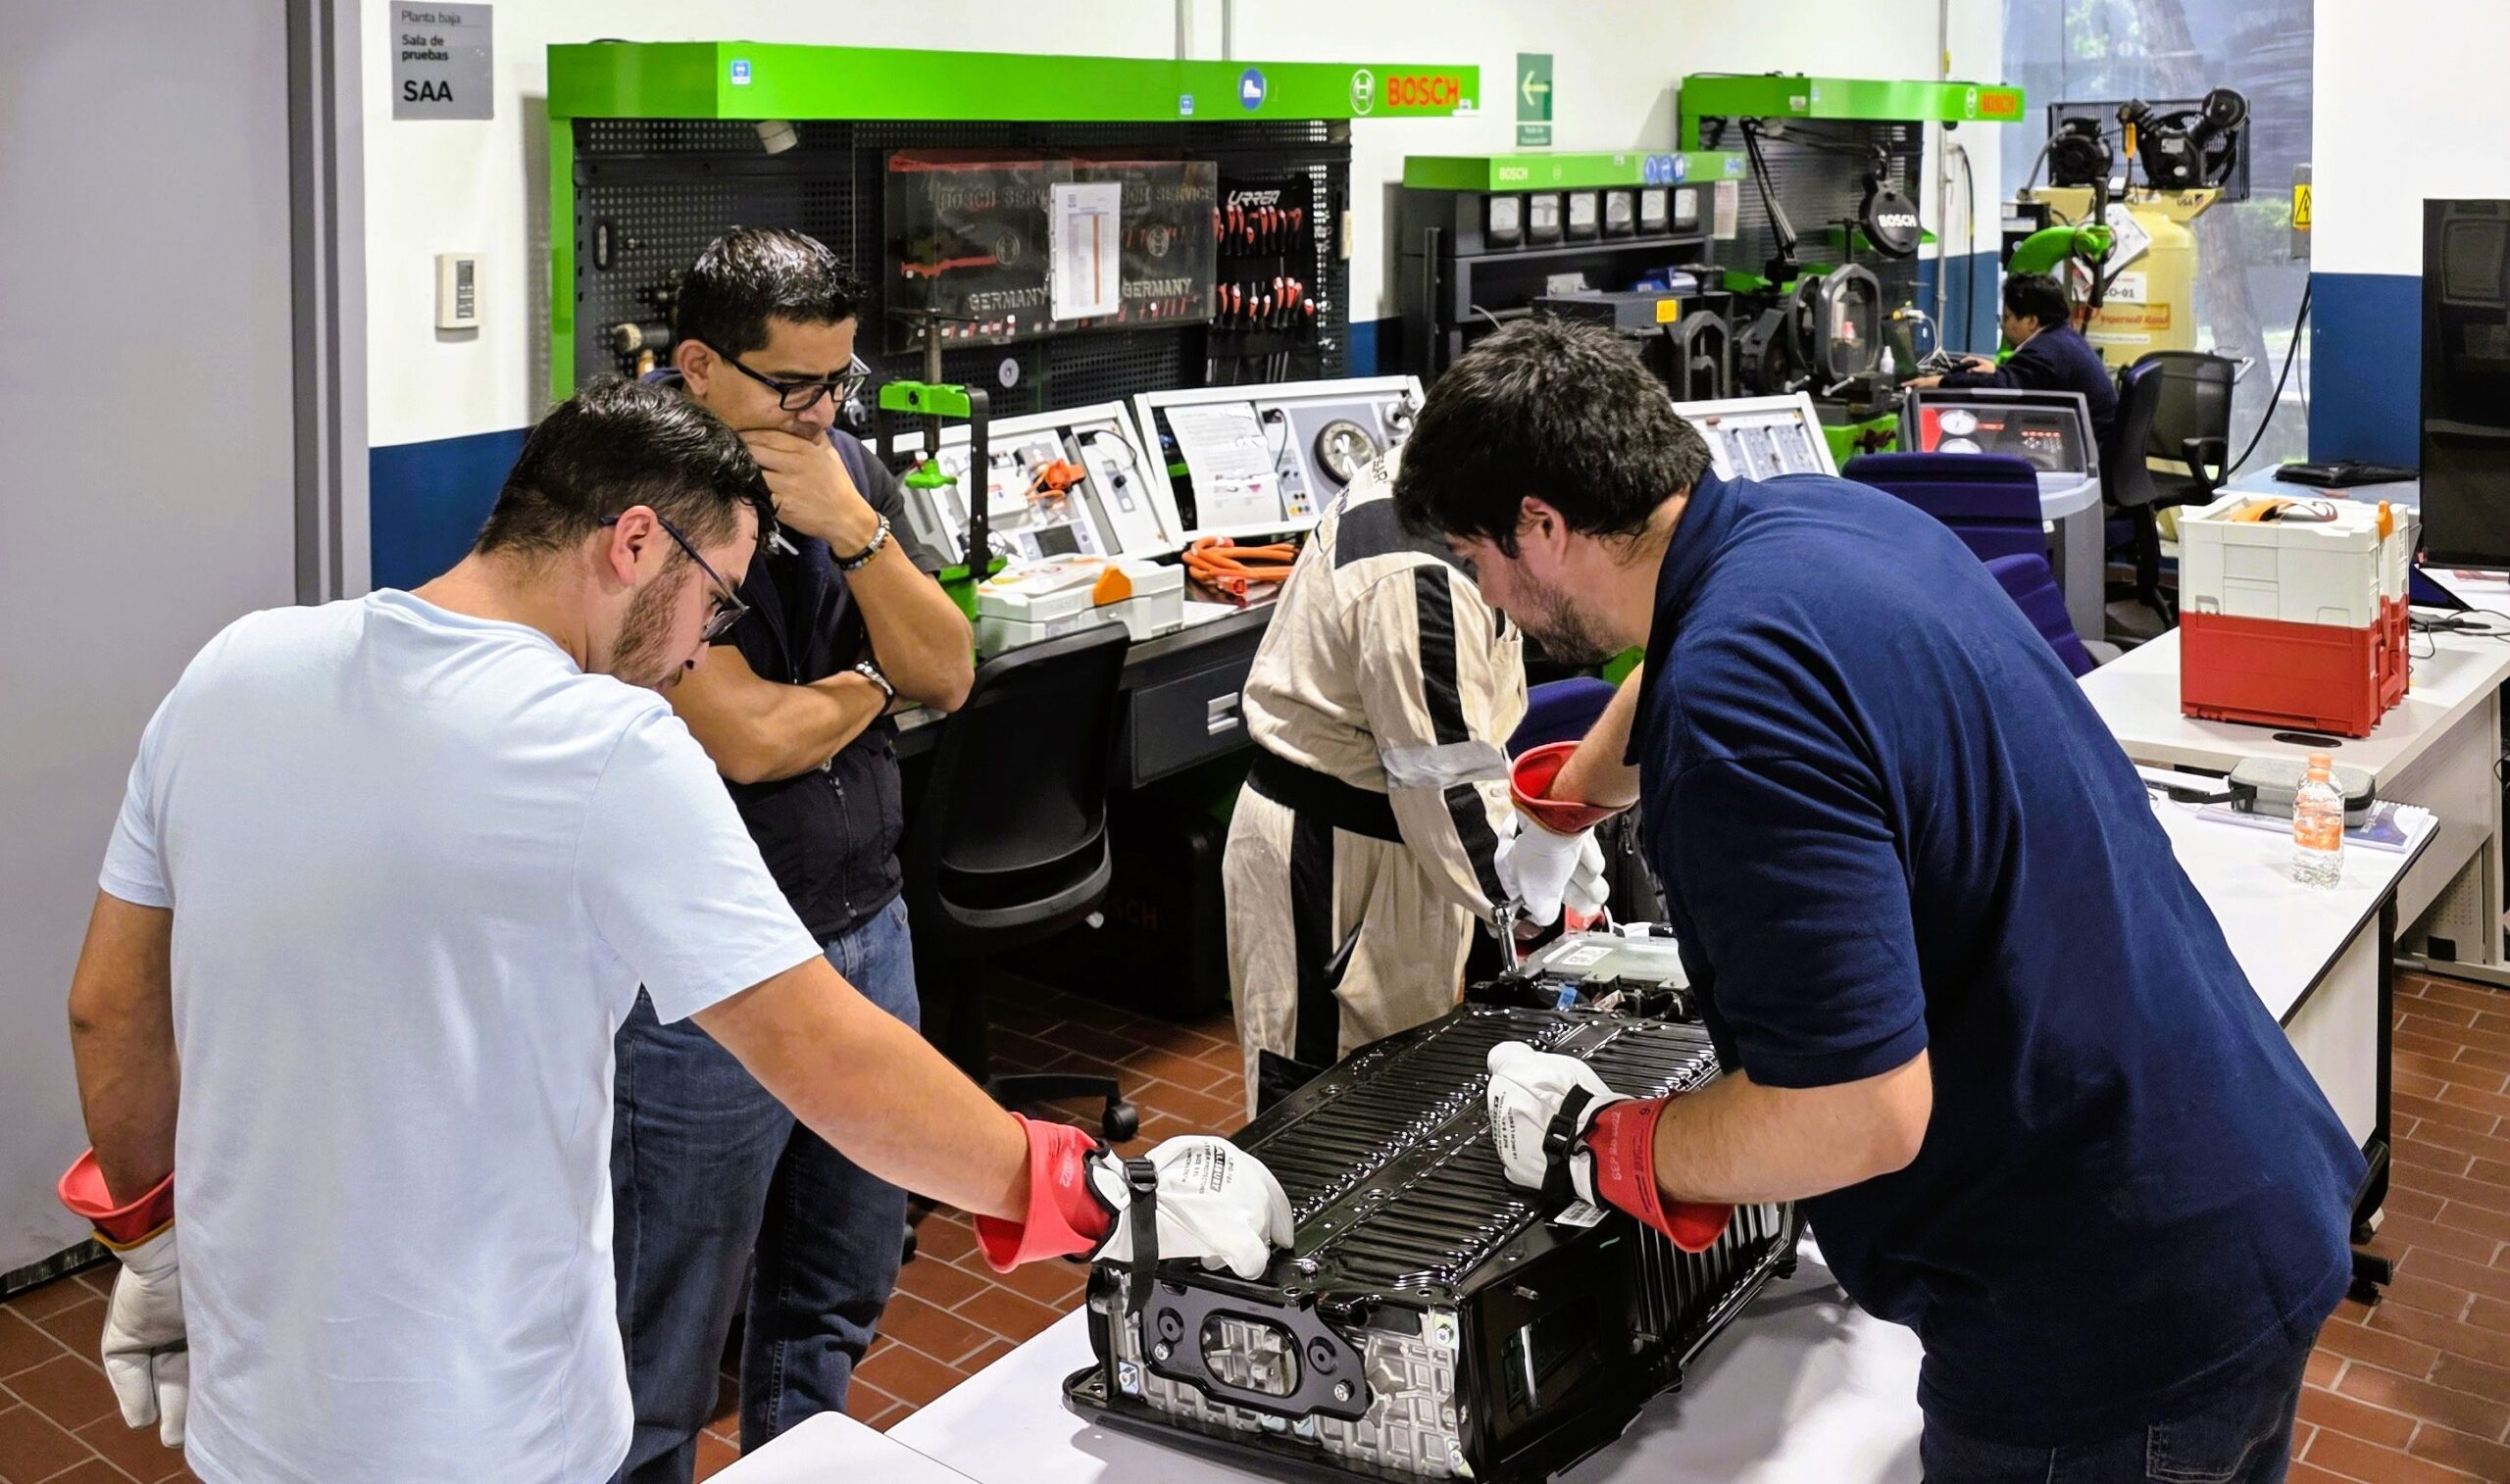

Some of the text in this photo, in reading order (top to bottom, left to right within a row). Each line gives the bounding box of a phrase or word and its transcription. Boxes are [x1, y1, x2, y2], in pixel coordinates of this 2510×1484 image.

[401, 10, 461, 25] Planta baja
[402, 33, 444, 46] Sala de
[401, 49, 449, 62] pruebas
[403, 79, 453, 102] SAA
[1387, 75, 1460, 106] BOSCH
[1499, 166, 1529, 181] BOSCH
[1227, 189, 1280, 207] URREA
[1878, 213, 1918, 227] BOSCH
[1122, 277, 1192, 298] GERMANY
[969, 287, 1050, 312] GERMANY
